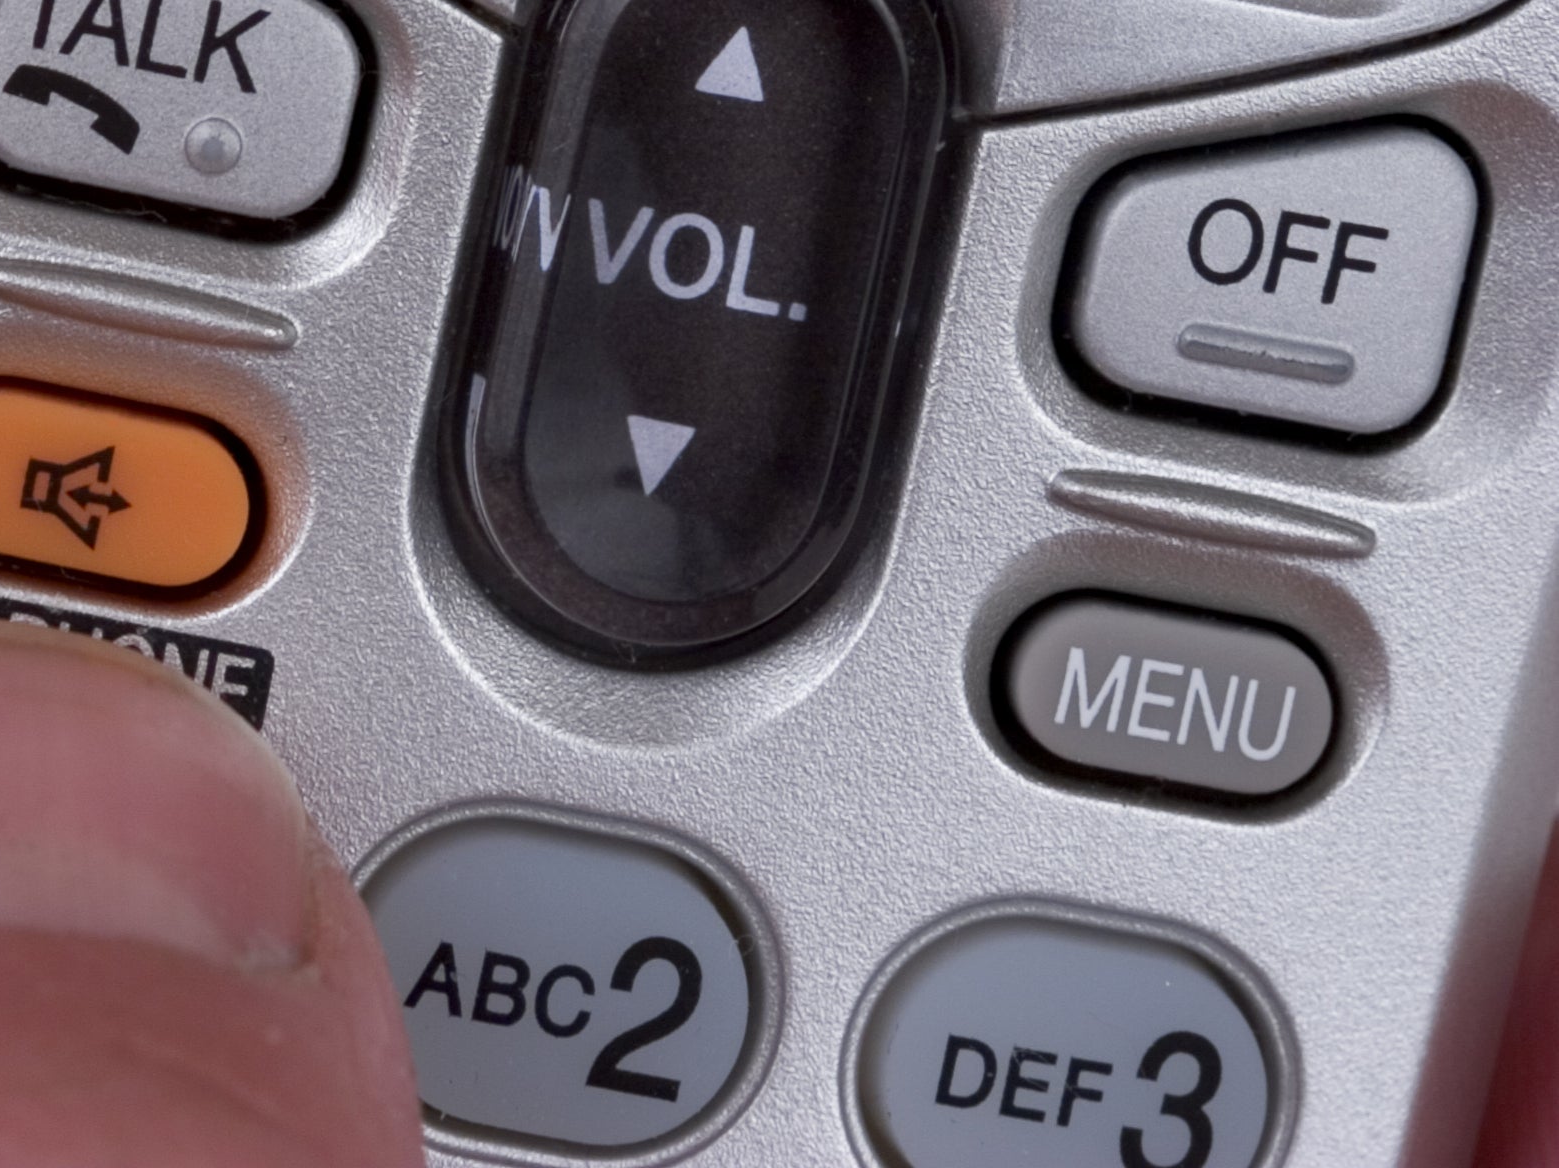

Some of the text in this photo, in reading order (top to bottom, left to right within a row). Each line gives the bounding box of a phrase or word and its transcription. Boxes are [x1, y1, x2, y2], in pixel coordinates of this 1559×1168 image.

[588, 197, 808, 322] VOL.
[1187, 198, 1390, 305] OFF
[1053, 647, 1296, 762] MENU
